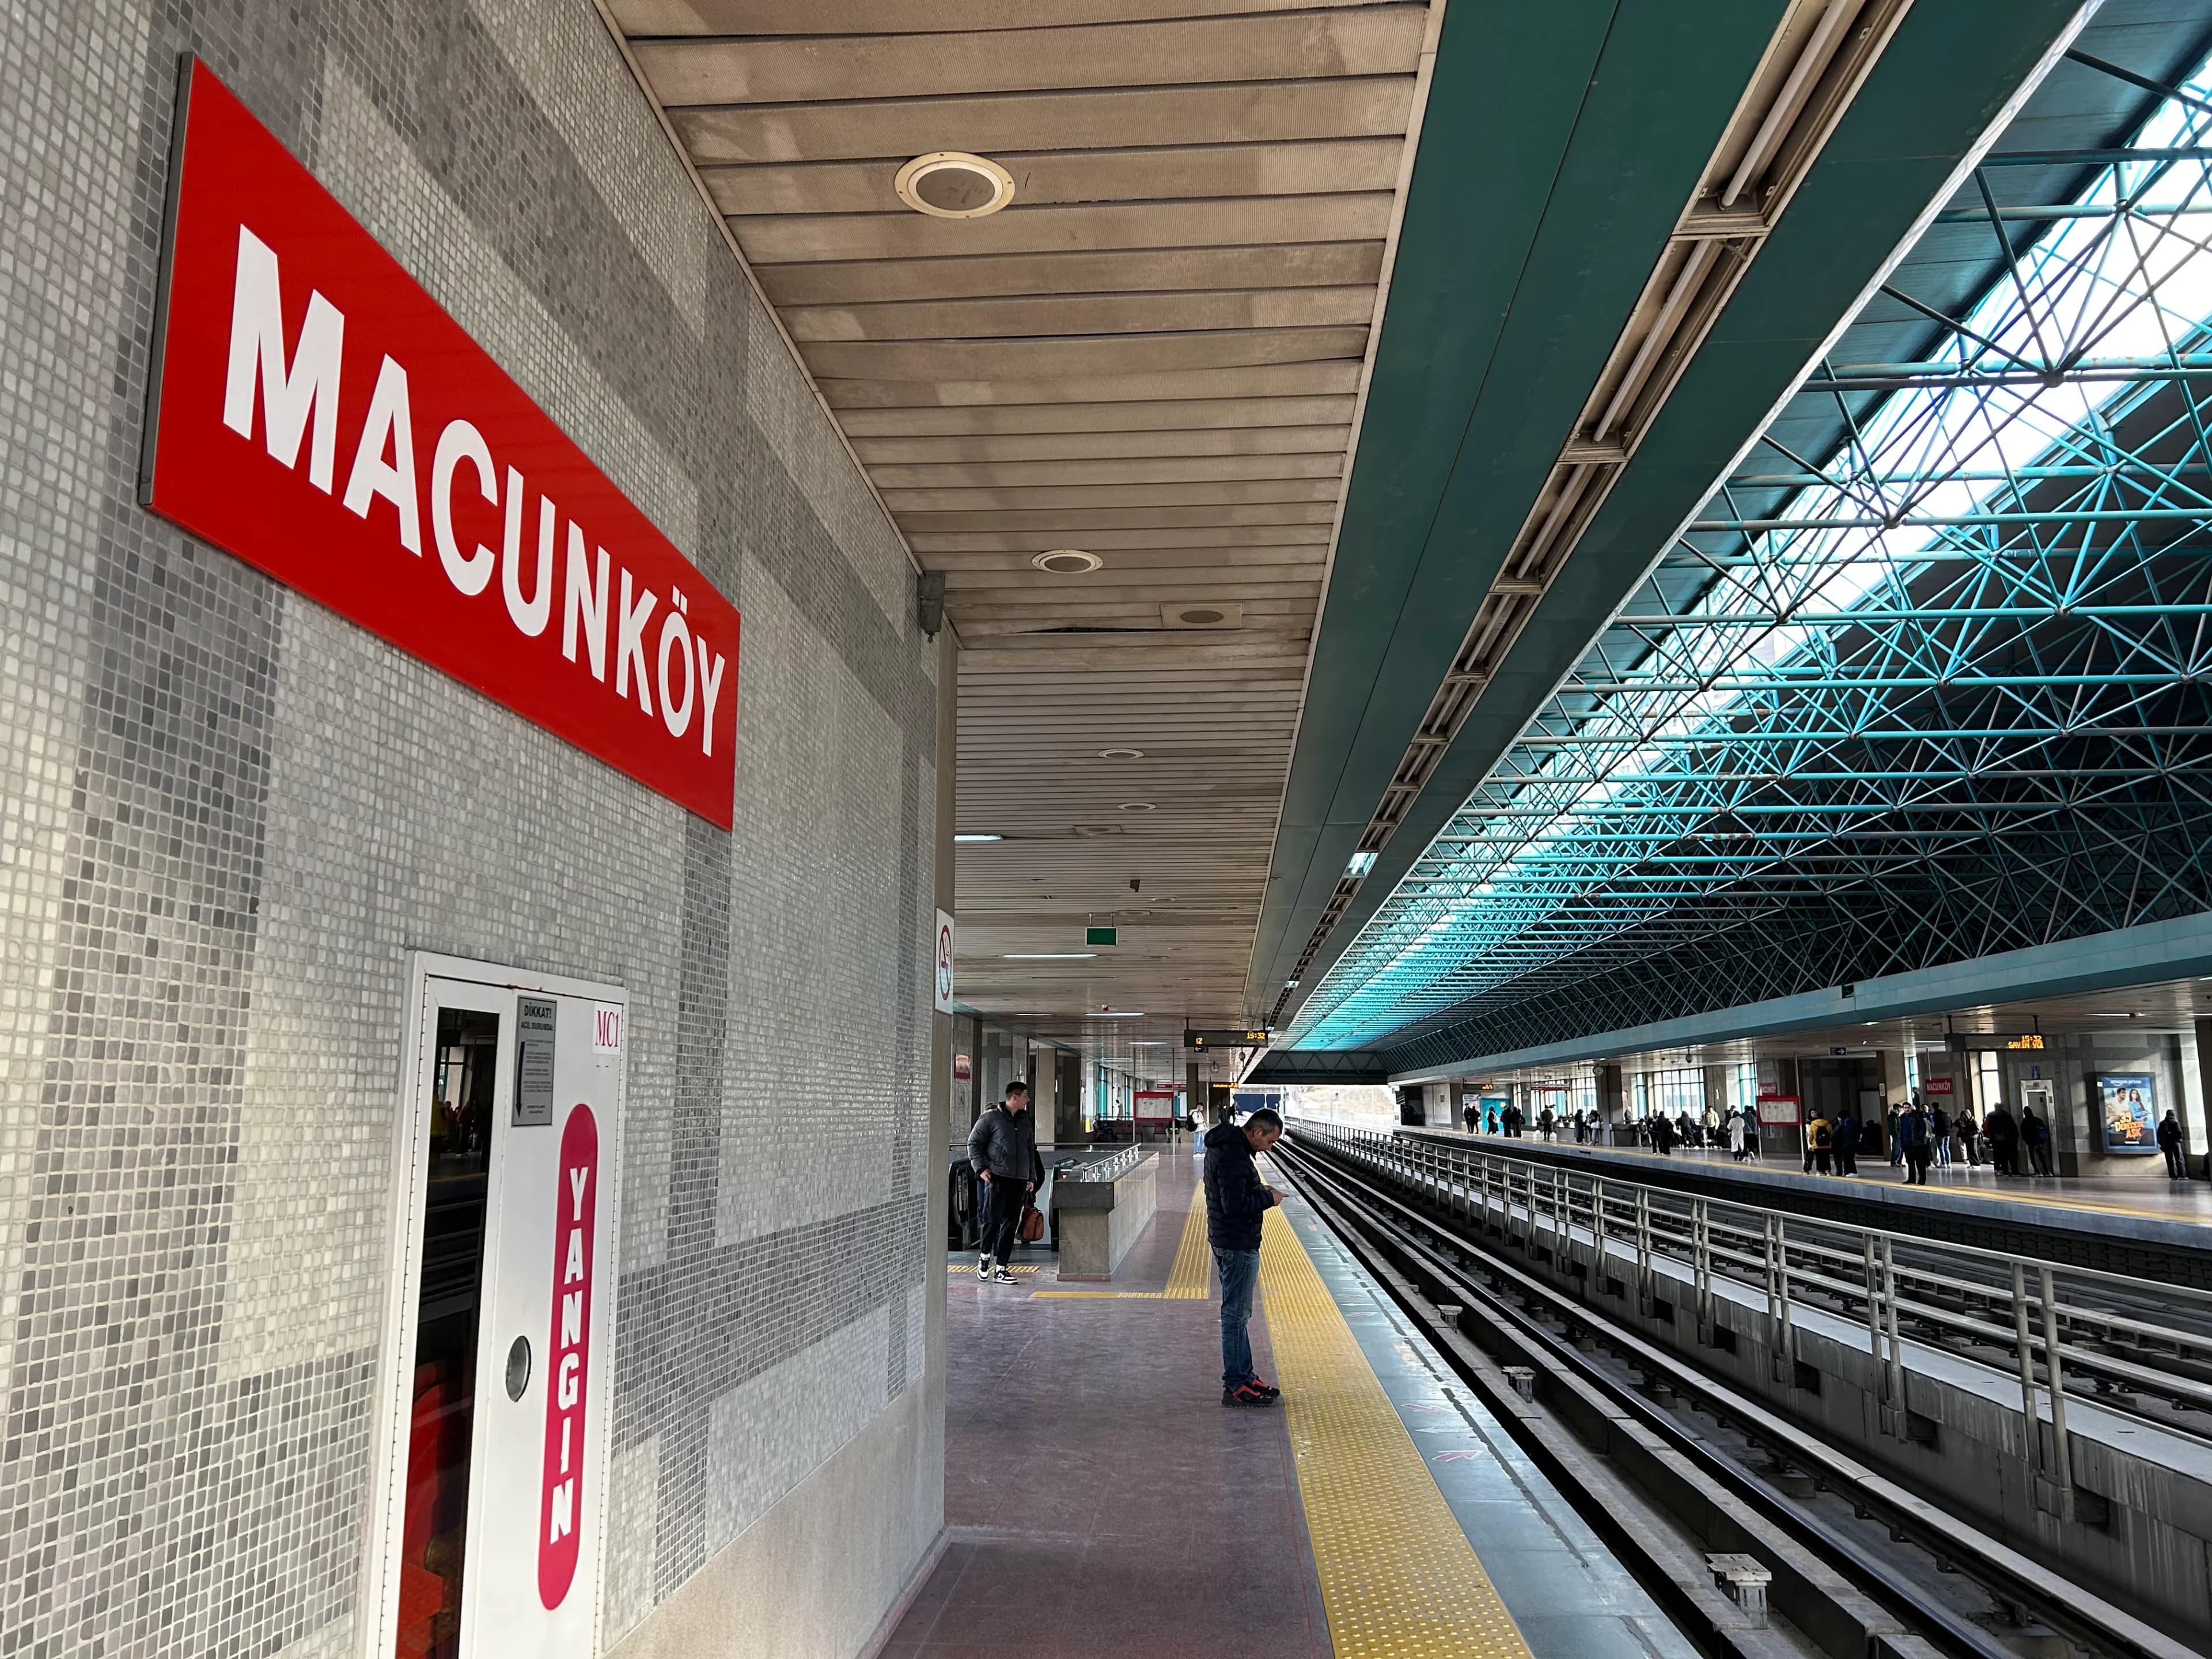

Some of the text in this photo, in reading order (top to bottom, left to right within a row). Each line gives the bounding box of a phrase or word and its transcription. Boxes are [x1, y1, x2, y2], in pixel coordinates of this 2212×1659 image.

[223, 223, 725, 756] MACUNKÖY
[524, 1002, 552, 1019] DİKKAT!
[594, 1010, 619, 1047] MC1
[549, 1166, 588, 1545] YANGIN
